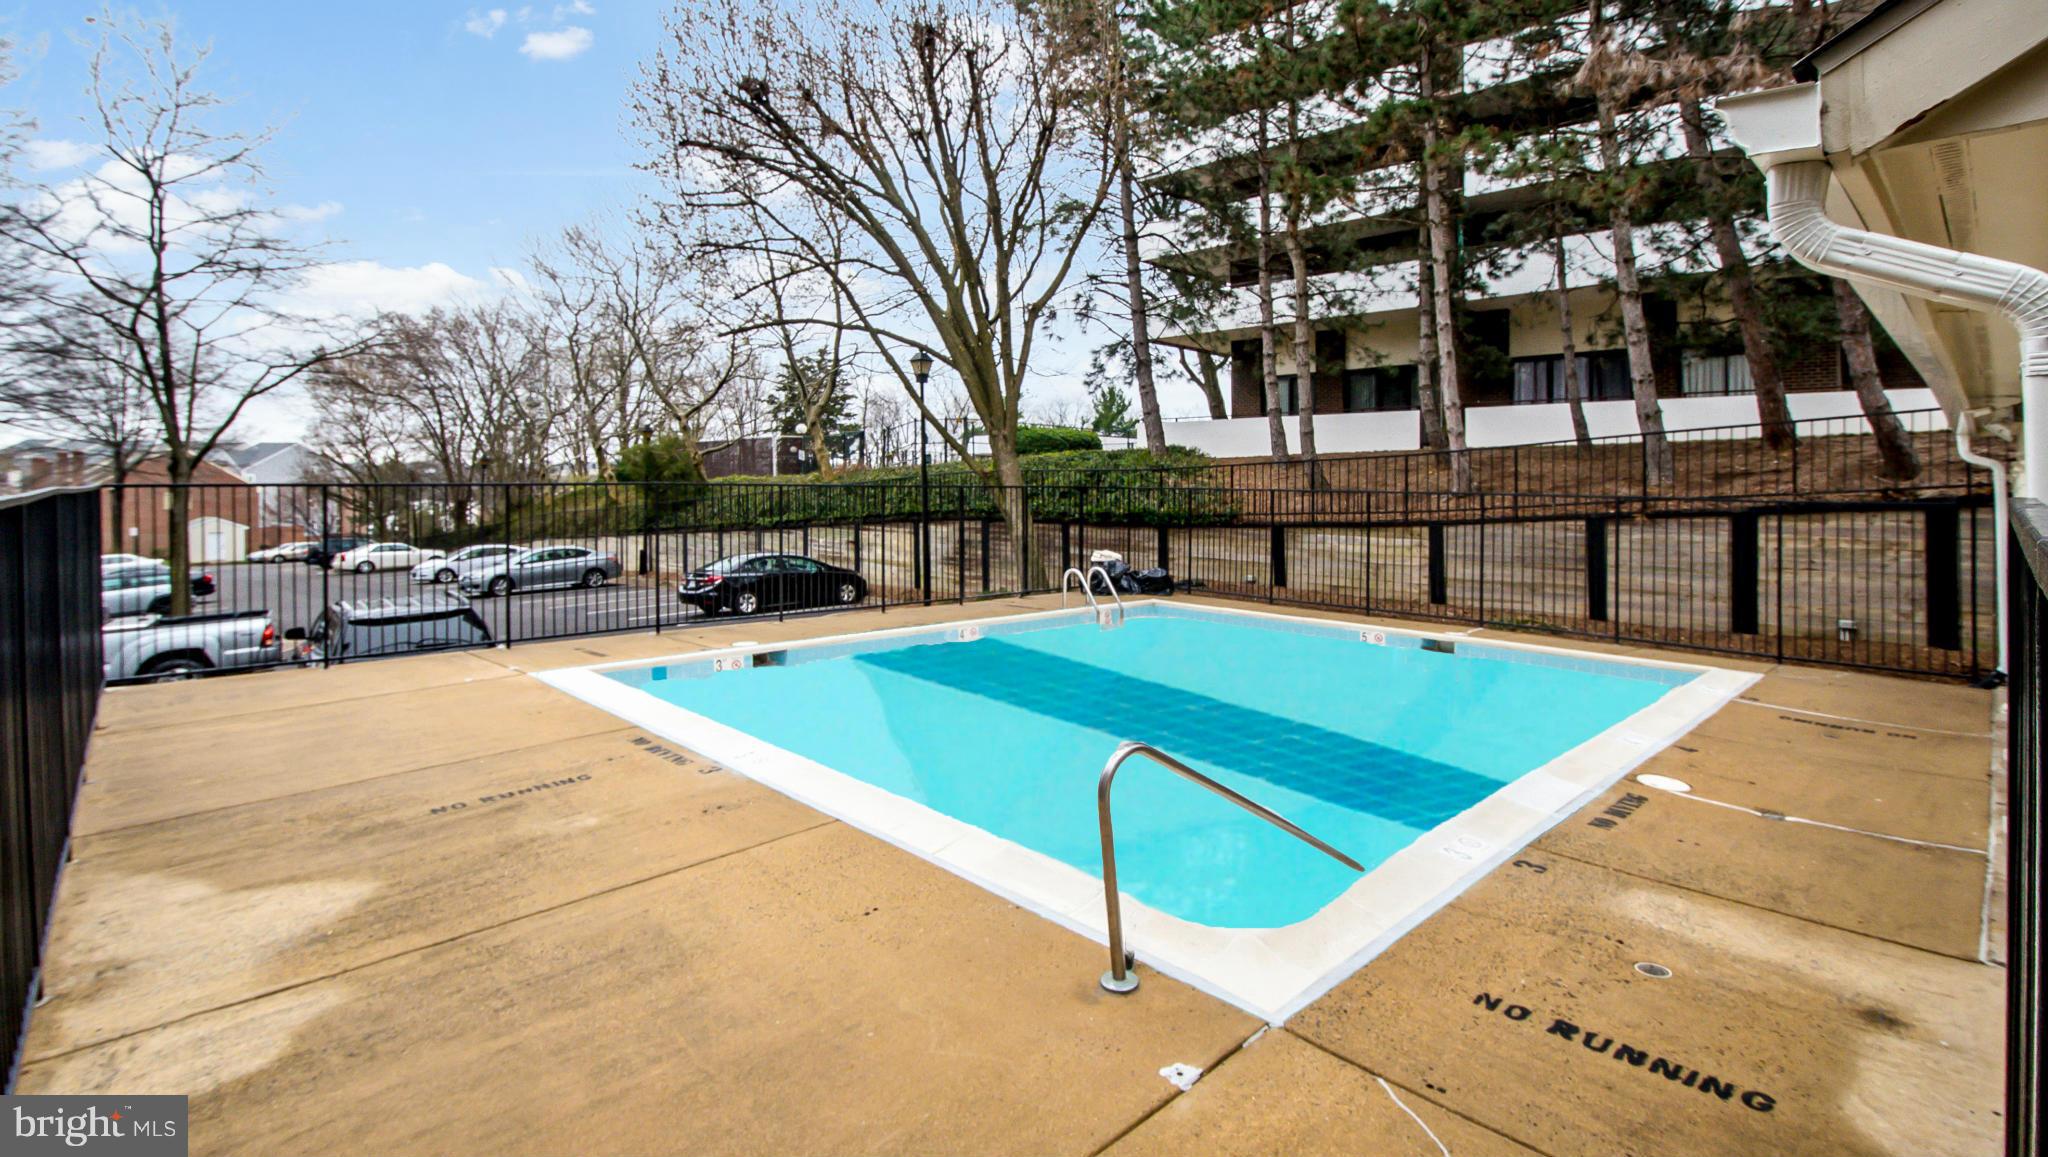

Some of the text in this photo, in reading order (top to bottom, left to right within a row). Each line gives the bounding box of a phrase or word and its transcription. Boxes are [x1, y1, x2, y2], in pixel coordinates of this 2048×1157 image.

[1361, 632, 1368, 642] 5
[715, 659, 722, 672] 3
[430, 774, 592, 815] NO RUNNING
[1512, 860, 1548, 874] 3
[1473, 992, 1777, 1113] NO RUNNING
